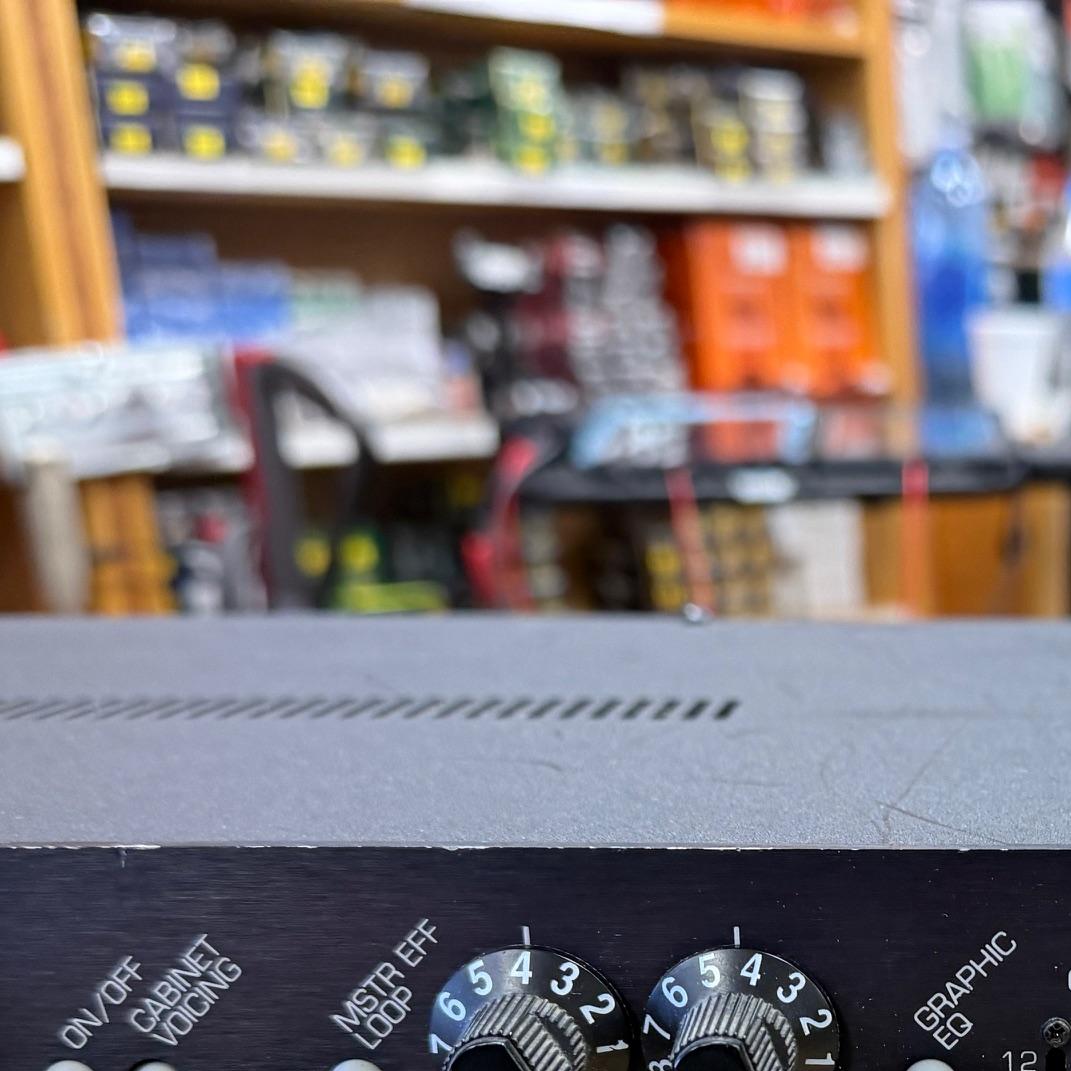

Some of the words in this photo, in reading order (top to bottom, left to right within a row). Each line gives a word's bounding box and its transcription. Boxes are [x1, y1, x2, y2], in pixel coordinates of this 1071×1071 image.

[129, 933, 220, 1033] CABINET
[330, 962, 405, 1034] MSTR
[393, 918, 438, 967] EFF
[466, 960, 493, 996] 5
[510, 951, 532, 984] 4
[550, 962, 581, 996] 3
[698, 953, 720, 988] 5
[739, 953, 763, 986] 4
[914, 931, 1017, 1031] GRAPHIC
[60, 956, 142, 1049] ON/OFF
[152, 957, 242, 1047] VOICING
[662, 976, 688, 1007] 6
[776, 972, 806, 1004] 3
[352, 986, 413, 1050] LOOP
[438, 991, 466, 1022] 6
[580, 994, 616, 1025] 2
[799, 1009, 833, 1037] 2
[643, 1014, 671, 1041] 7
[933, 1012, 974, 1050] EQ
[596, 1039, 629, 1053] 1
[805, 1053, 835, 1069] 1
